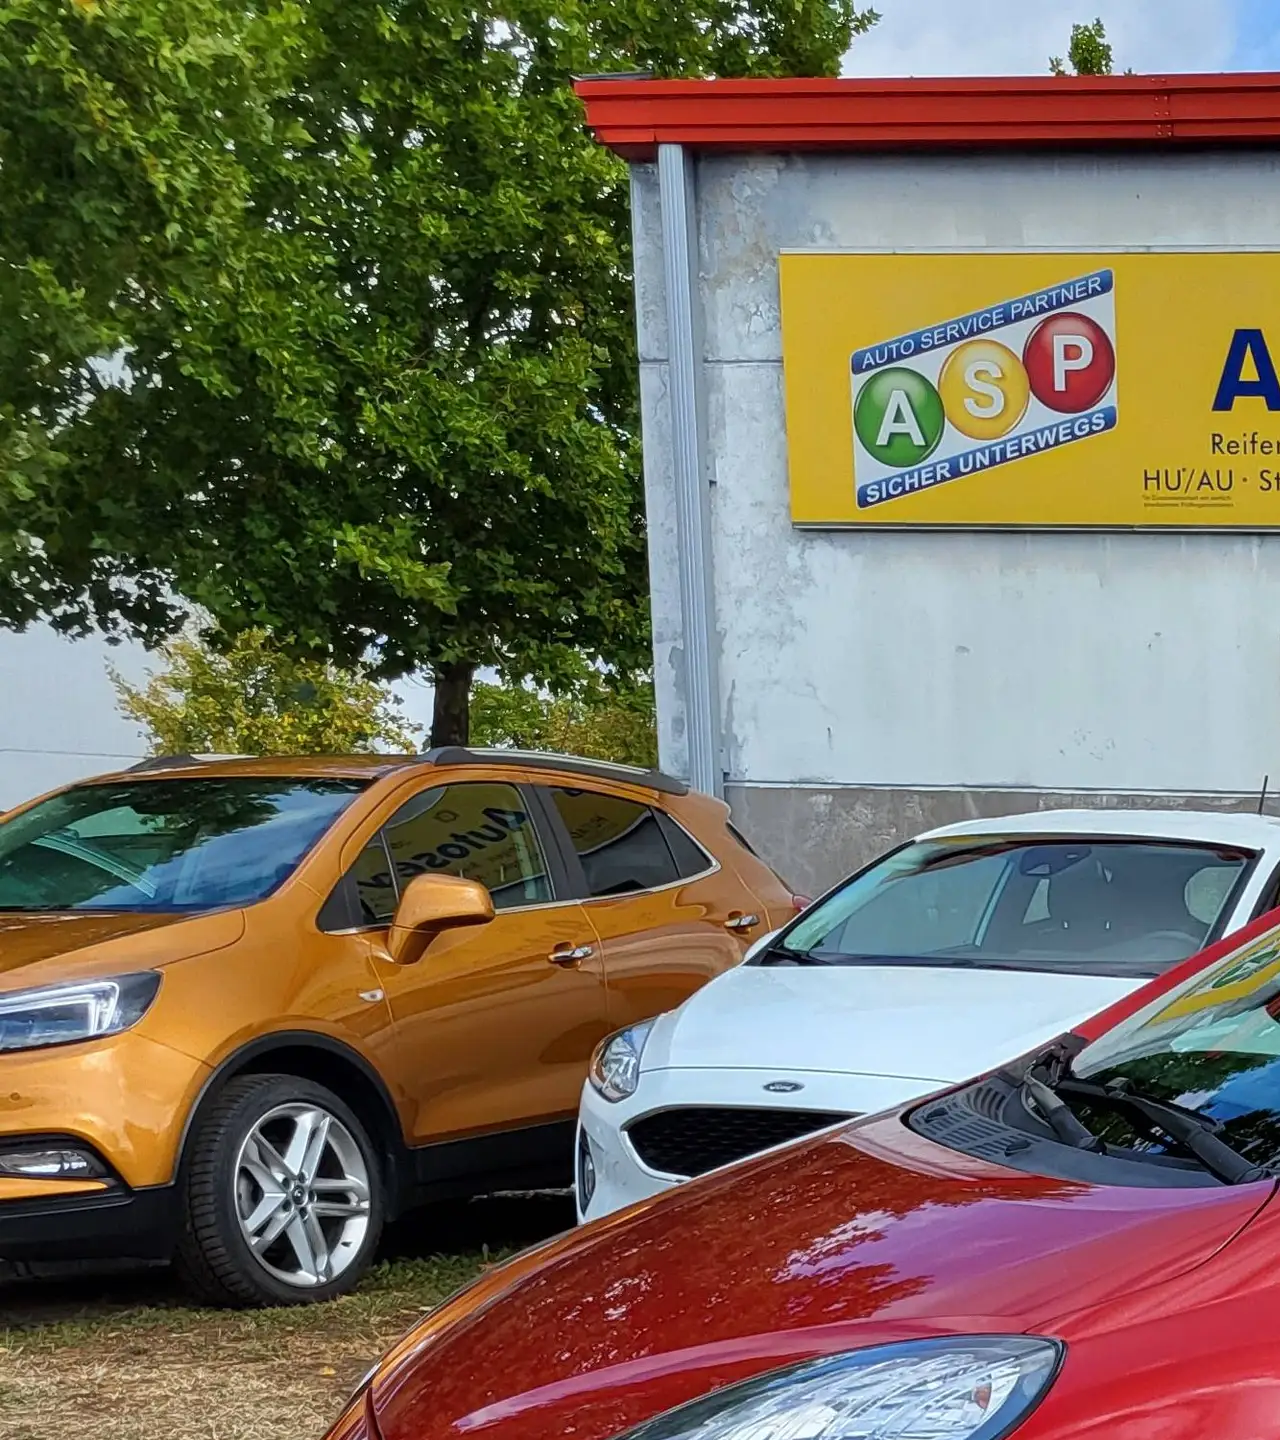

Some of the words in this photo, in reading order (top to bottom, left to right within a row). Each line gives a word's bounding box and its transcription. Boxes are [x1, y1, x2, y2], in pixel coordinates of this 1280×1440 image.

[861, 338, 915, 370] AUTO
[920, 307, 1005, 351] SERVICE
[1010, 275, 1103, 320] PARTNER
[866, 462, 952, 505] SICHER
[959, 412, 1107, 475] UNTERWEGS
